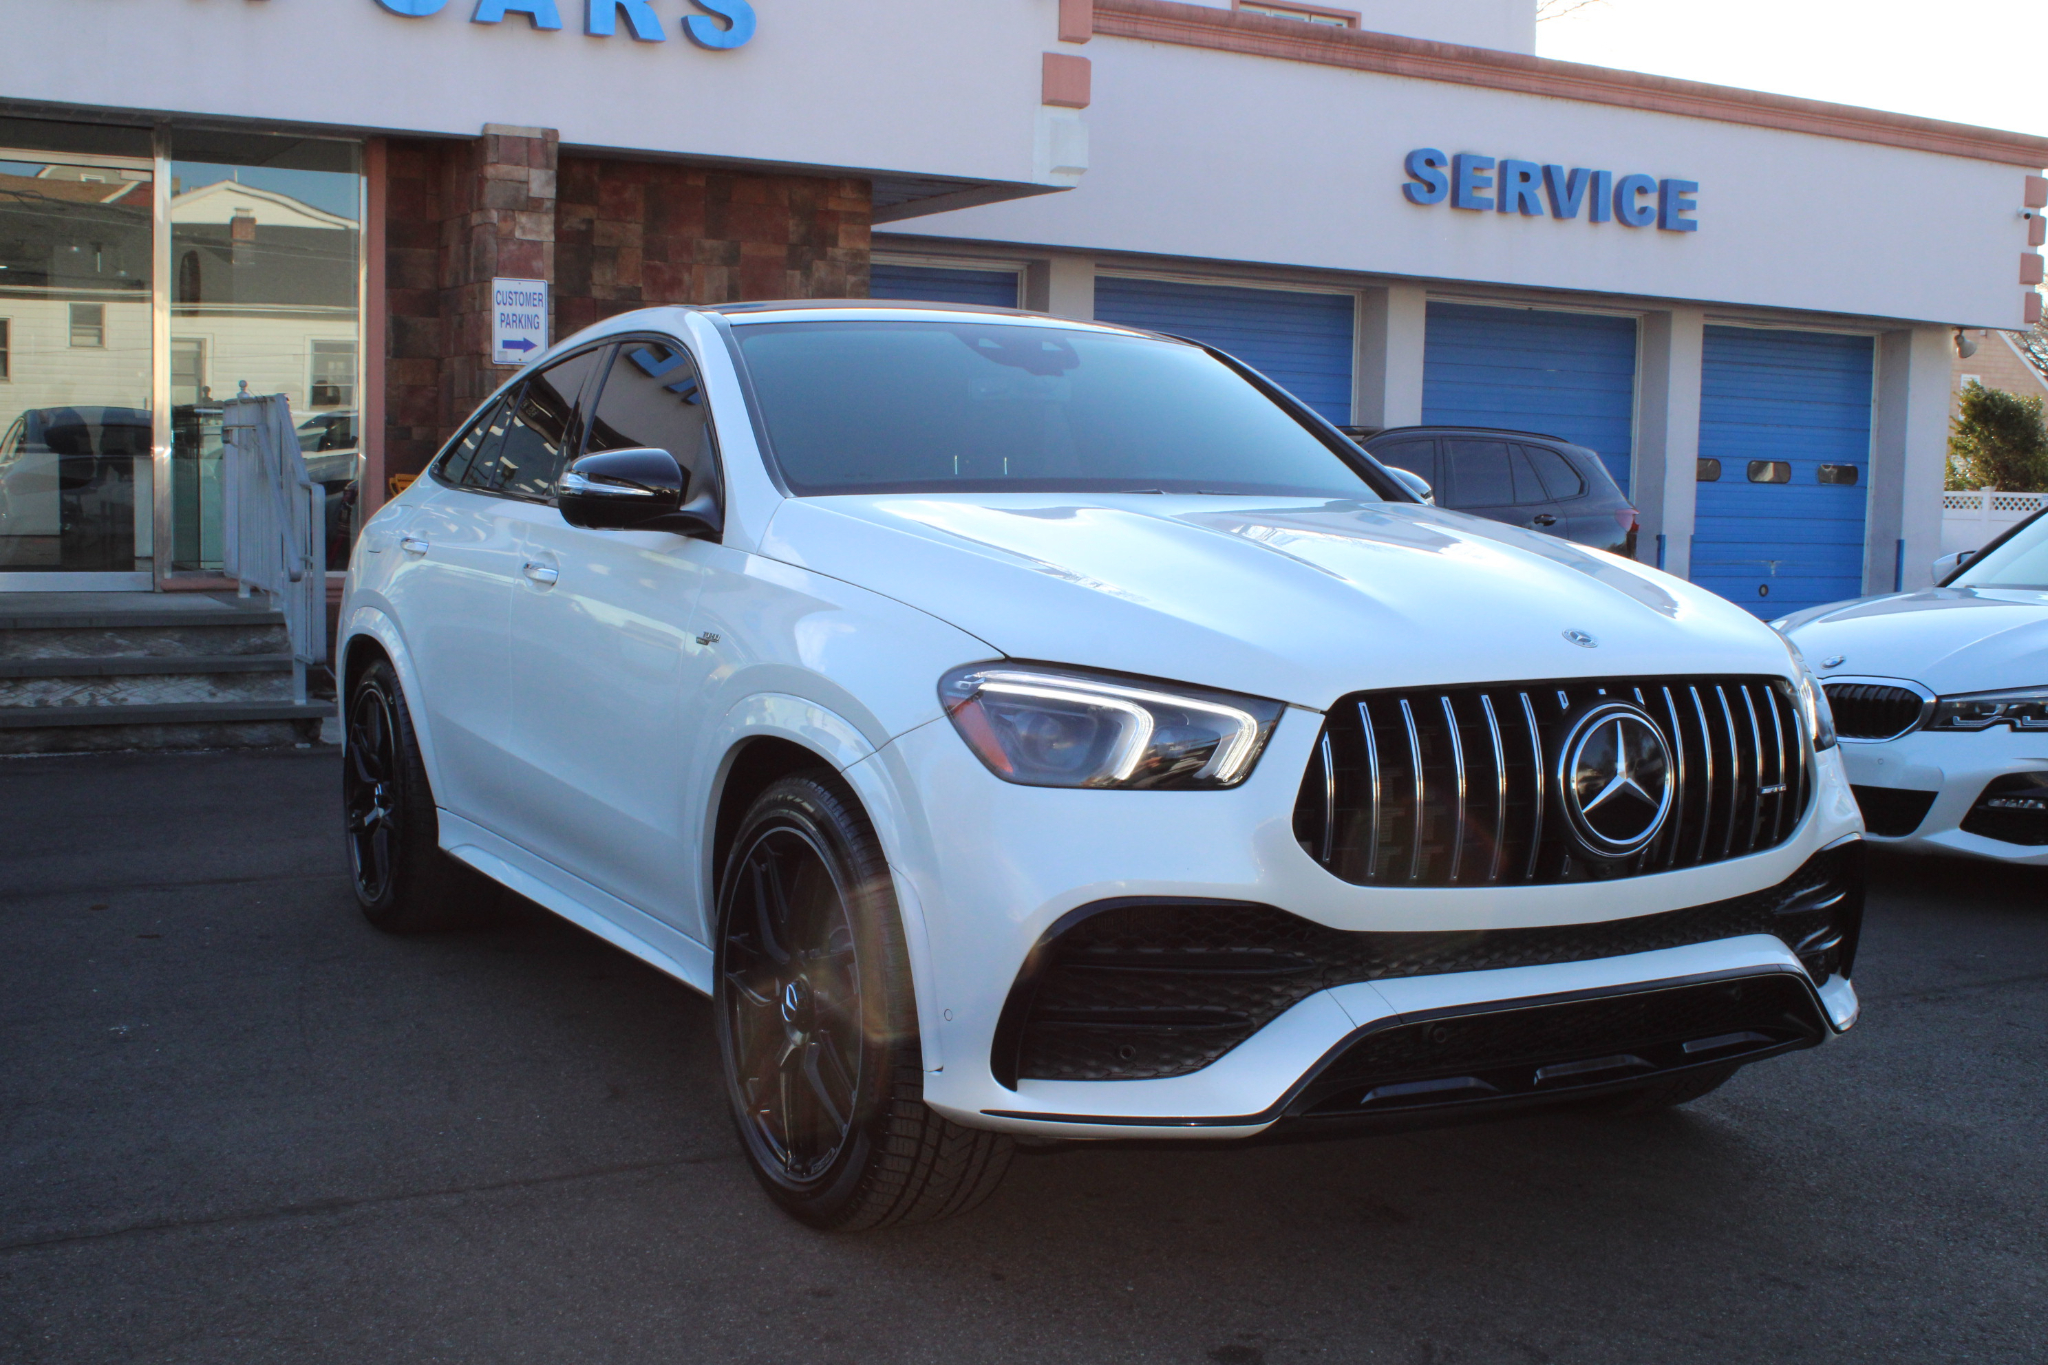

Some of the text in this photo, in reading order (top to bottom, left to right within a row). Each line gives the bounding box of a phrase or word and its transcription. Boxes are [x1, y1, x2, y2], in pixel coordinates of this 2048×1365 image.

[374, 0, 757, 51] ARS
[1402, 147, 1699, 232] SERVICE
[496, 290, 544, 308] CUSTOMER
[500, 312, 540, 330] PARKING
